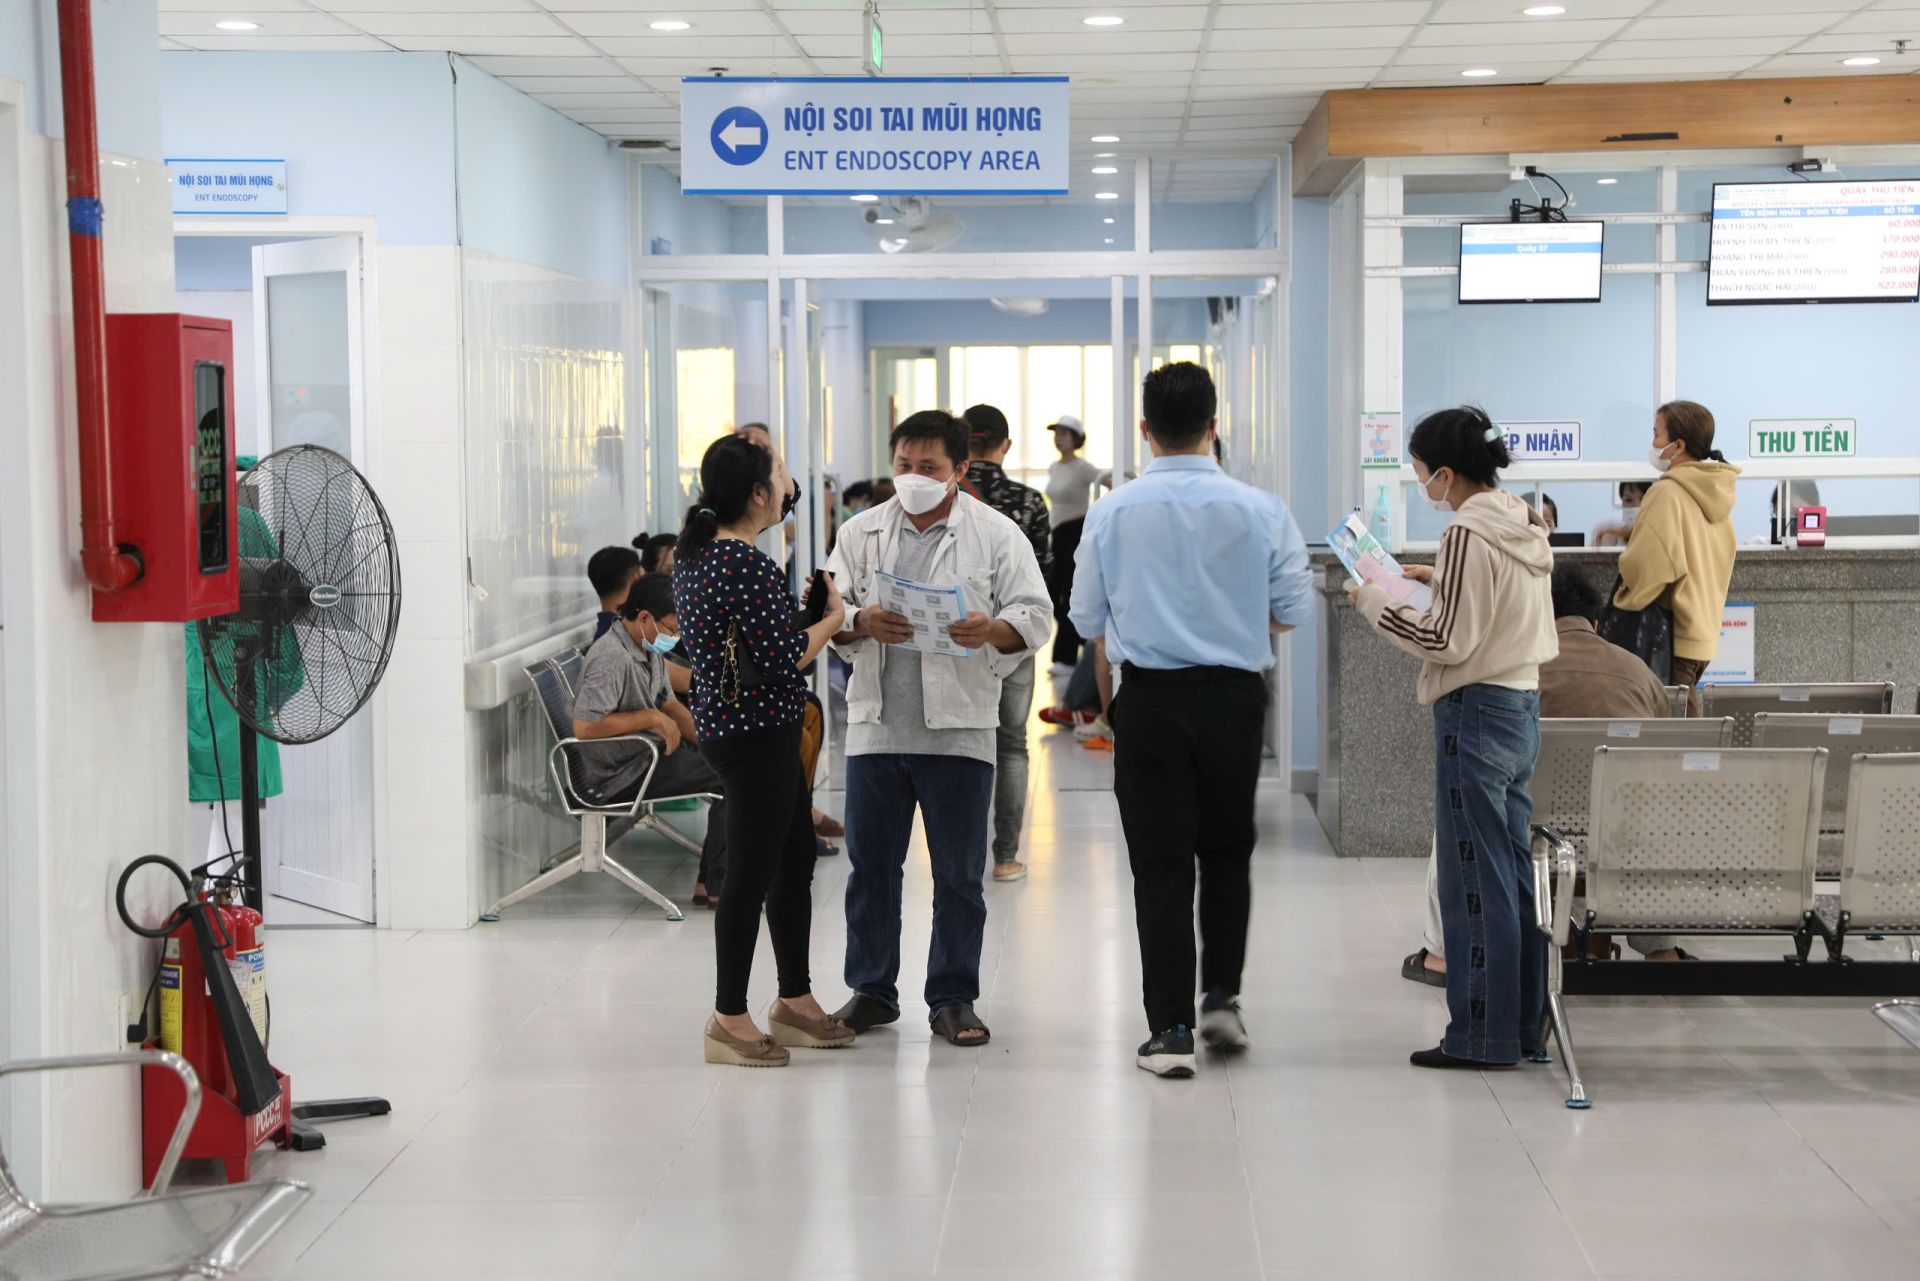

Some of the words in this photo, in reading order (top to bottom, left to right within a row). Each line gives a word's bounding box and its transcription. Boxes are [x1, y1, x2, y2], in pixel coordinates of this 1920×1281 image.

[784, 102, 825, 137] NỘI
[833, 107, 872, 132] SOI
[880, 107, 913, 132] TAI
[922, 102, 968, 132] MŨI
[976, 107, 1041, 137] HỌNG
[784, 150, 828, 170] ENT
[836, 150, 972, 170] ENDOSCOPY
[979, 150, 1041, 170] AREA
[179, 172, 195, 188] NỘI
[197, 175, 212, 186] SOI
[214, 175, 227, 186] TAI
[249, 175, 273, 188] HỌNG
[195, 193, 209, 201] ENT
[212, 193, 258, 202] ENDOSCOPY
[1526, 428, 1573, 456] NHẬN
[1756, 431, 1796, 453] THU
[1802, 423, 1848, 452] TIỀN
